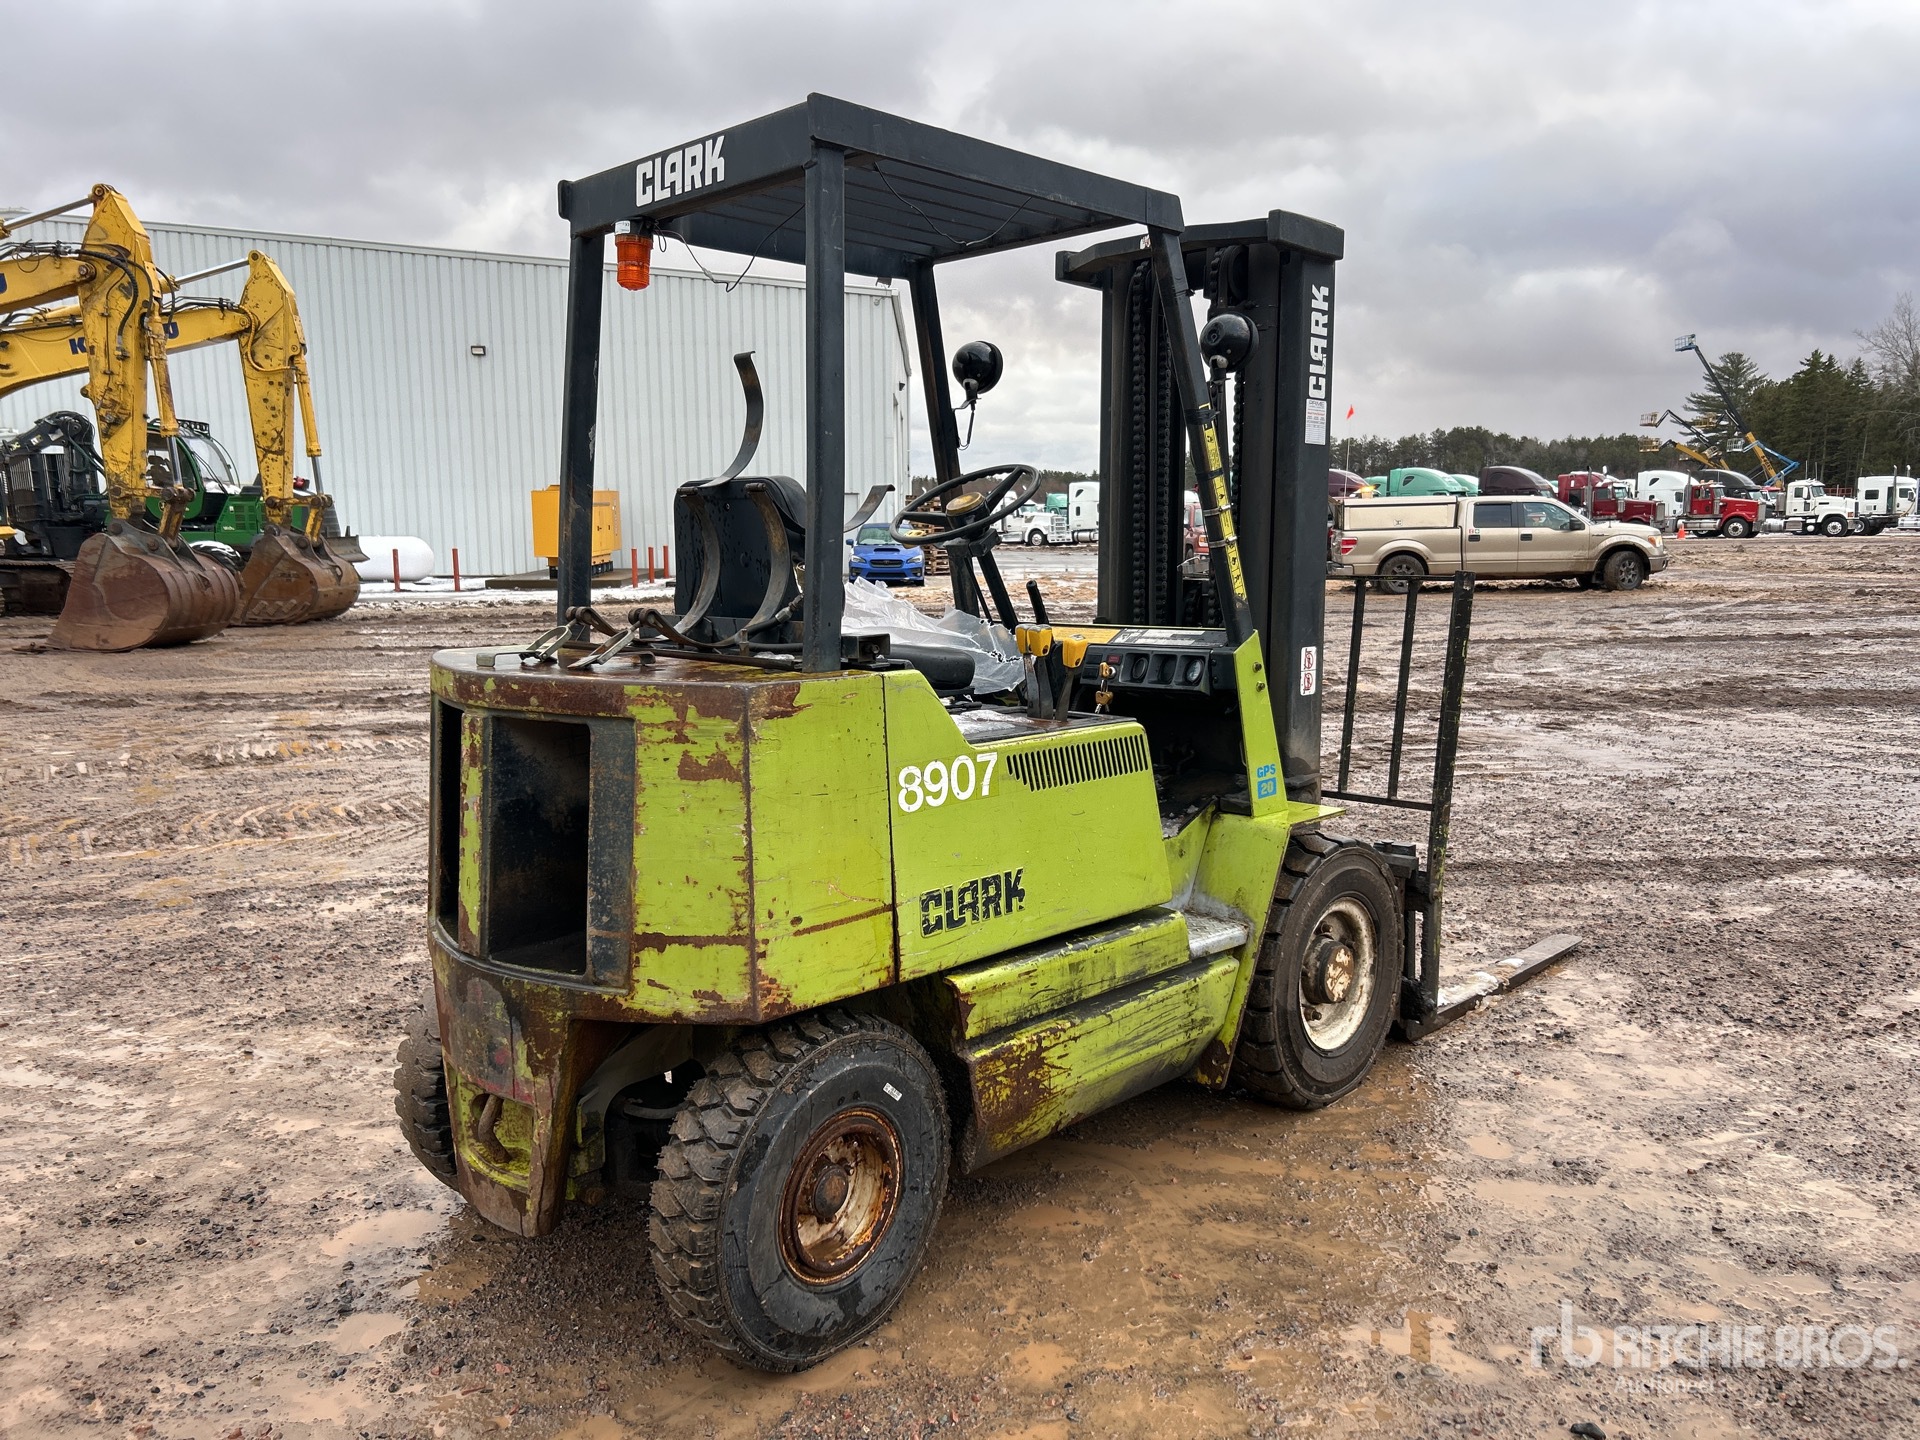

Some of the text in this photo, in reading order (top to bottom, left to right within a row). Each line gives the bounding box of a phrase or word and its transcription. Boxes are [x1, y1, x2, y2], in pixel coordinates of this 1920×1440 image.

[636, 135, 725, 208] CLARK
[1308, 284, 1330, 399] CLARK
[898, 752, 998, 813] 8907
[1257, 763, 1276, 778] GPS
[1260, 780, 1274, 795] 20
[919, 866, 1026, 939] CLARK
